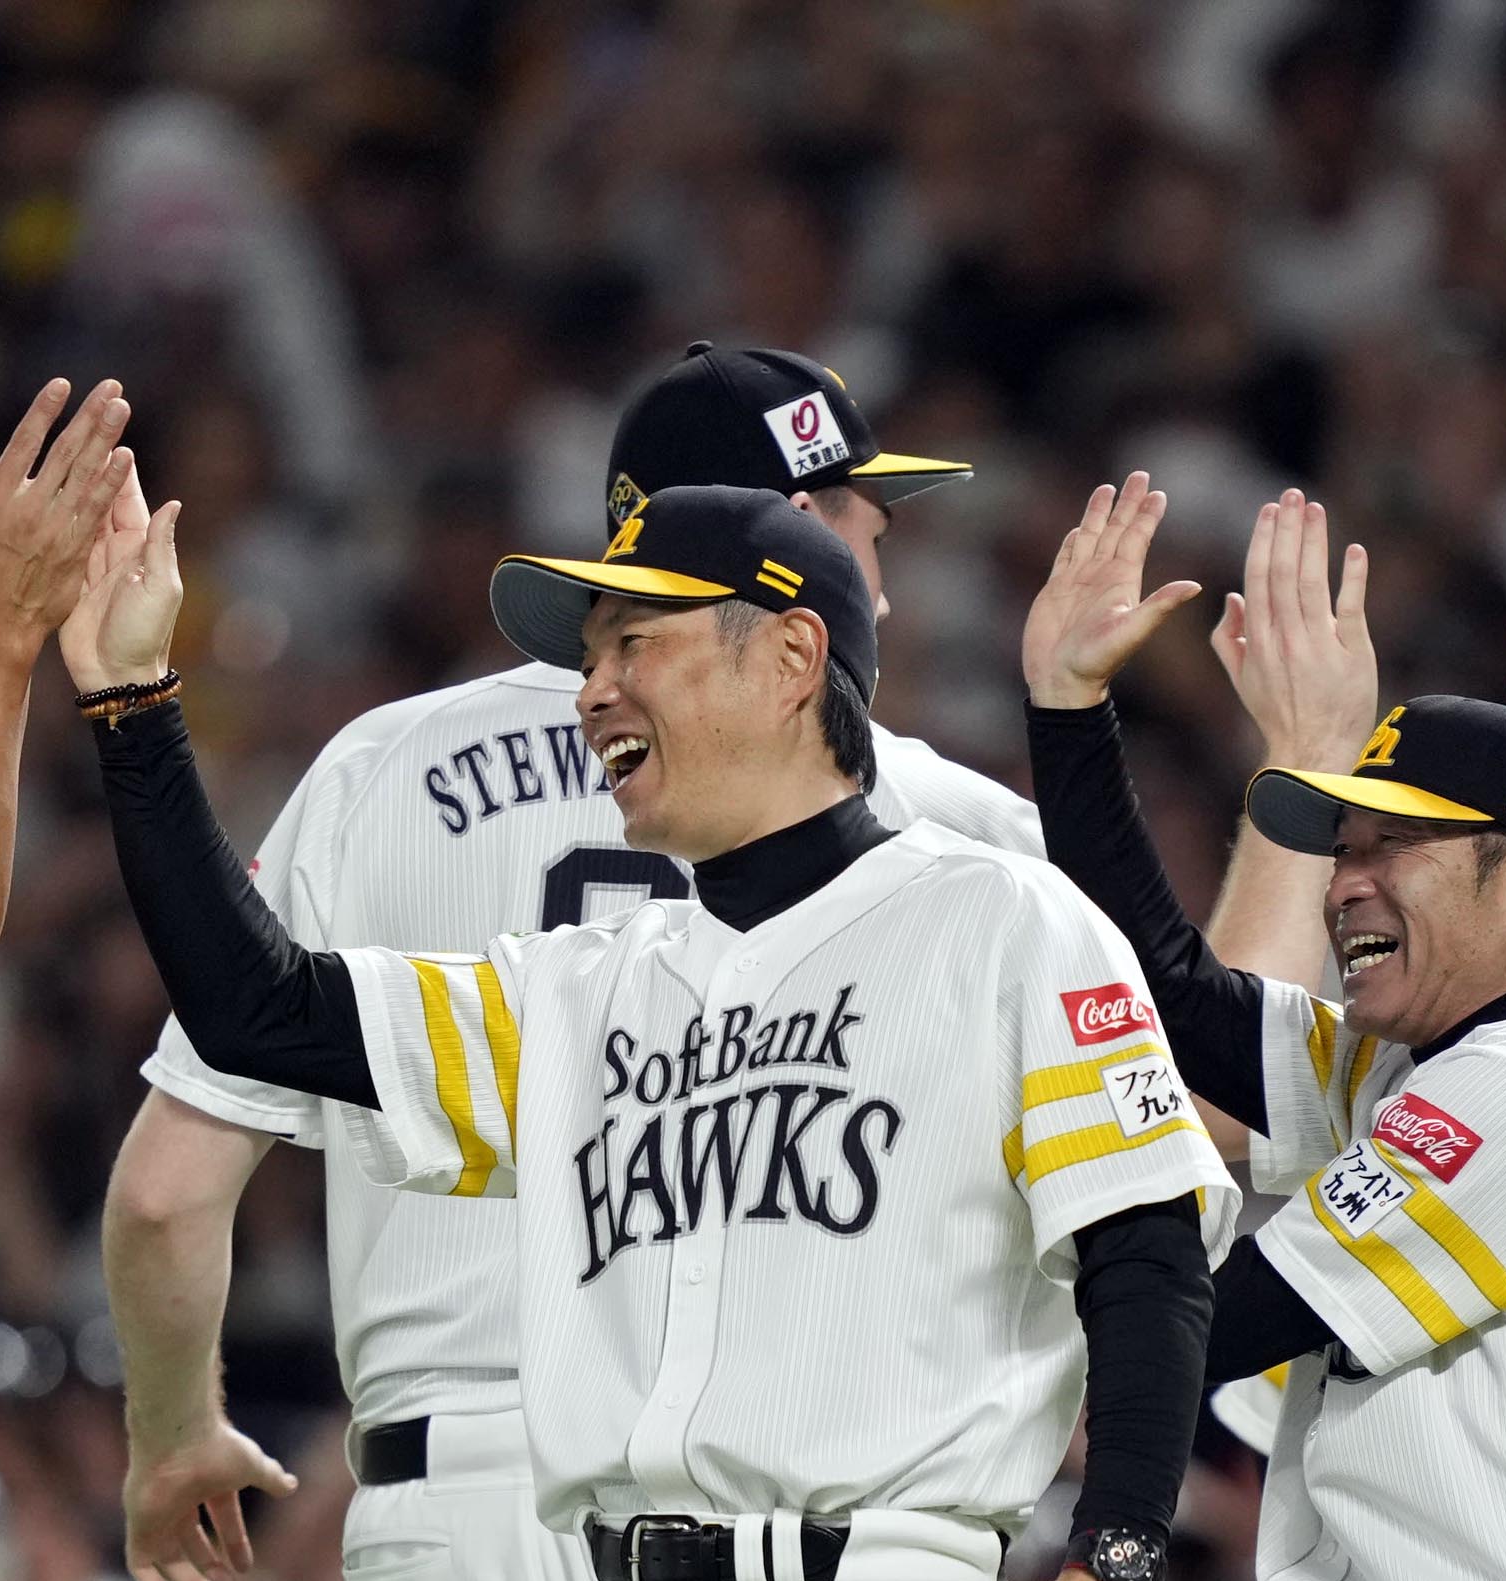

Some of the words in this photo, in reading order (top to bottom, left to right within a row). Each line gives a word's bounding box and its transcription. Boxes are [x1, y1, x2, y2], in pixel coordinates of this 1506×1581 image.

[425, 724, 612, 837] STEW
[603, 982, 865, 1106] SoftBank
[572, 1080, 905, 1288] HAWKS
[1378, 1099, 1474, 1164] Coca-Cola
